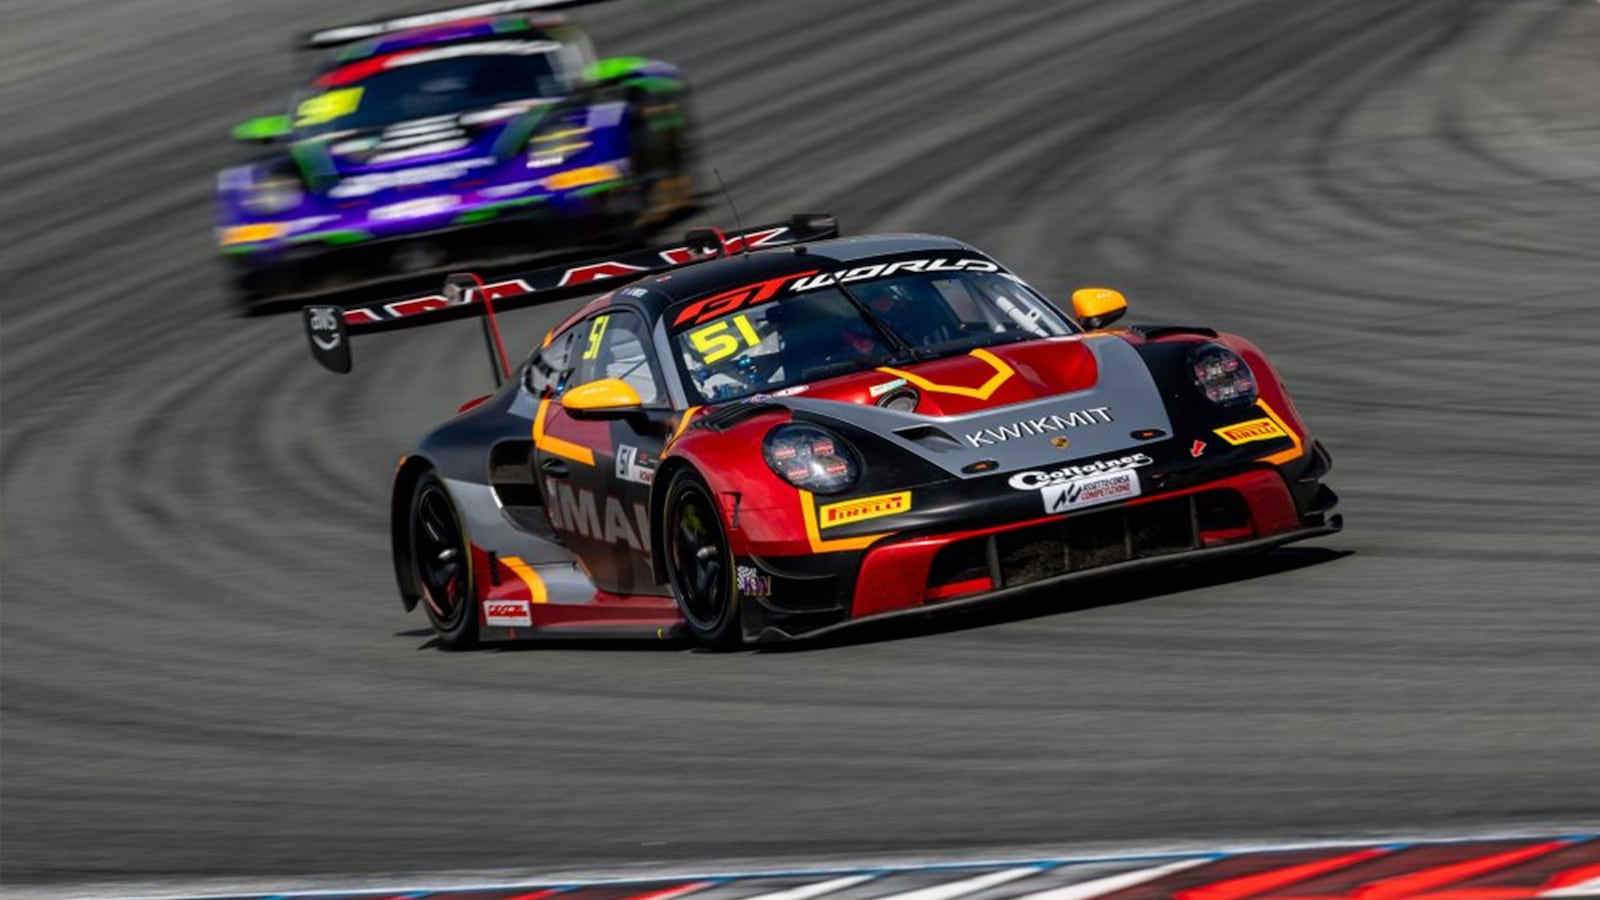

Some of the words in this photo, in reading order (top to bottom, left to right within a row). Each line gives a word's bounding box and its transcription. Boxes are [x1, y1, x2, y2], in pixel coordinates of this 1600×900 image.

[789, 258, 999, 293] WORLD
[583, 314, 610, 360] 51
[688, 314, 761, 364] 51
[965, 406, 1114, 449] KWIKMIT
[1008, 452, 1154, 491] Cooltainer
[828, 496, 902, 521] PIRELLI
